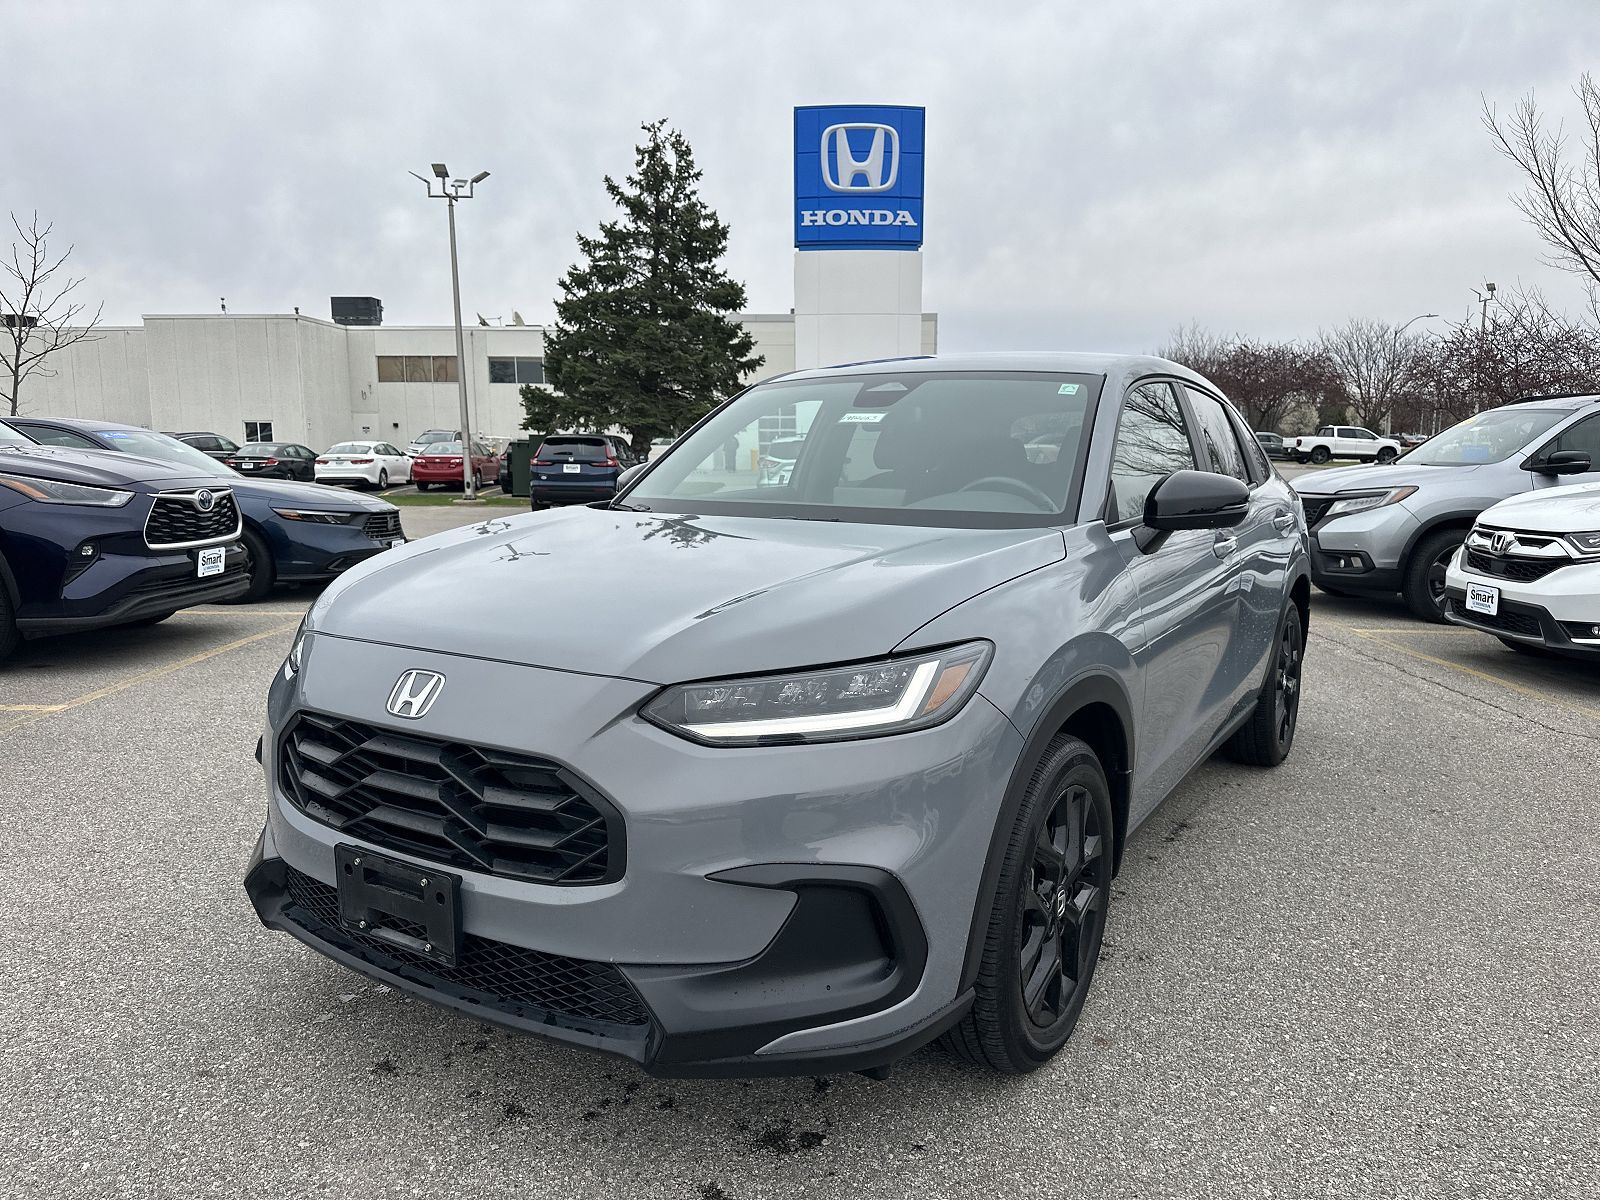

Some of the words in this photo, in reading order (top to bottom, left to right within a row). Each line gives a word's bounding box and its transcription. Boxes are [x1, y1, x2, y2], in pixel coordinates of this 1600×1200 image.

[801, 210, 918, 226] HONDA
[201, 554, 222, 566] Smart
[1470, 589, 1495, 604] Smart
